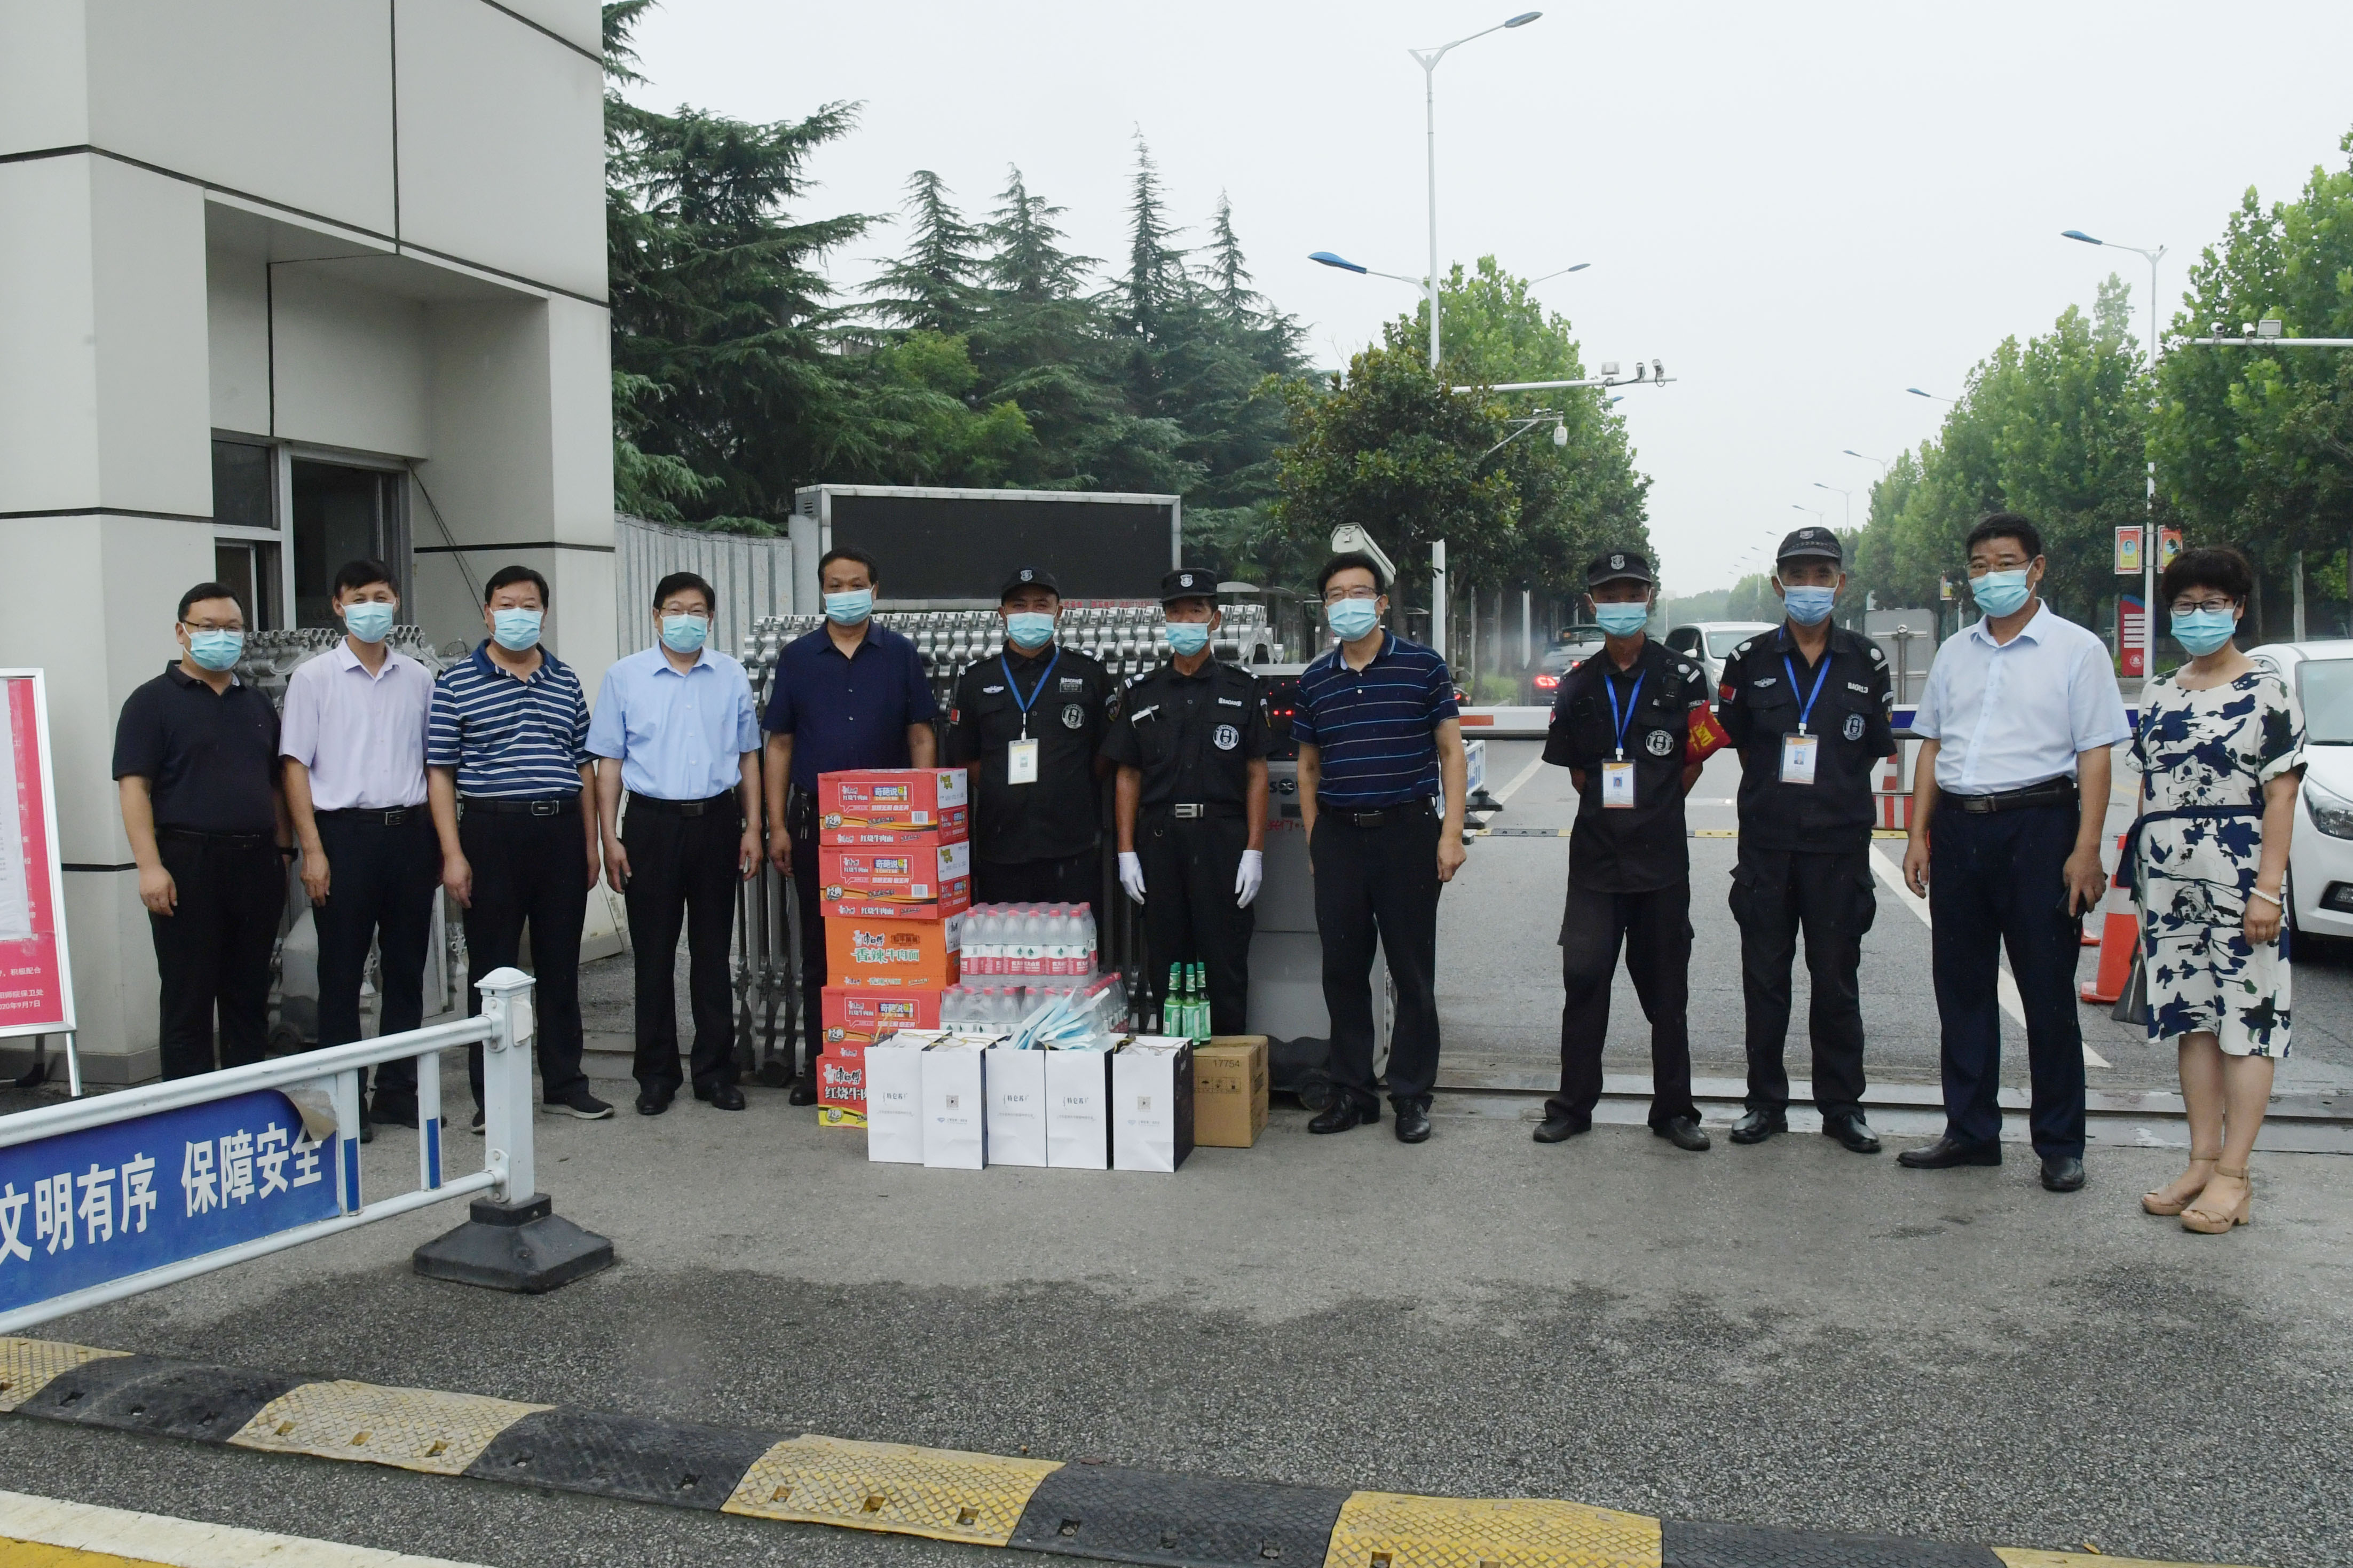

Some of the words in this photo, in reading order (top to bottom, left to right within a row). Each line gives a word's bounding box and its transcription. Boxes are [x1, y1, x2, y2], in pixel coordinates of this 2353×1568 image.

[875, 787, 898, 796] 奇葩说
[825, 815, 842, 825] 经典
[876, 859, 898, 868] 奇葩说
[861, 907, 894, 915] 红烧牛肉面
[863, 932, 885, 945] 康师傅
[855, 948, 919, 963] 香辣牛肉面
[1214, 1059, 1240, 1068] 17754
[835, 1067, 862, 1084] 康师傅
[181, 1122, 322, 1217] 保障安全
